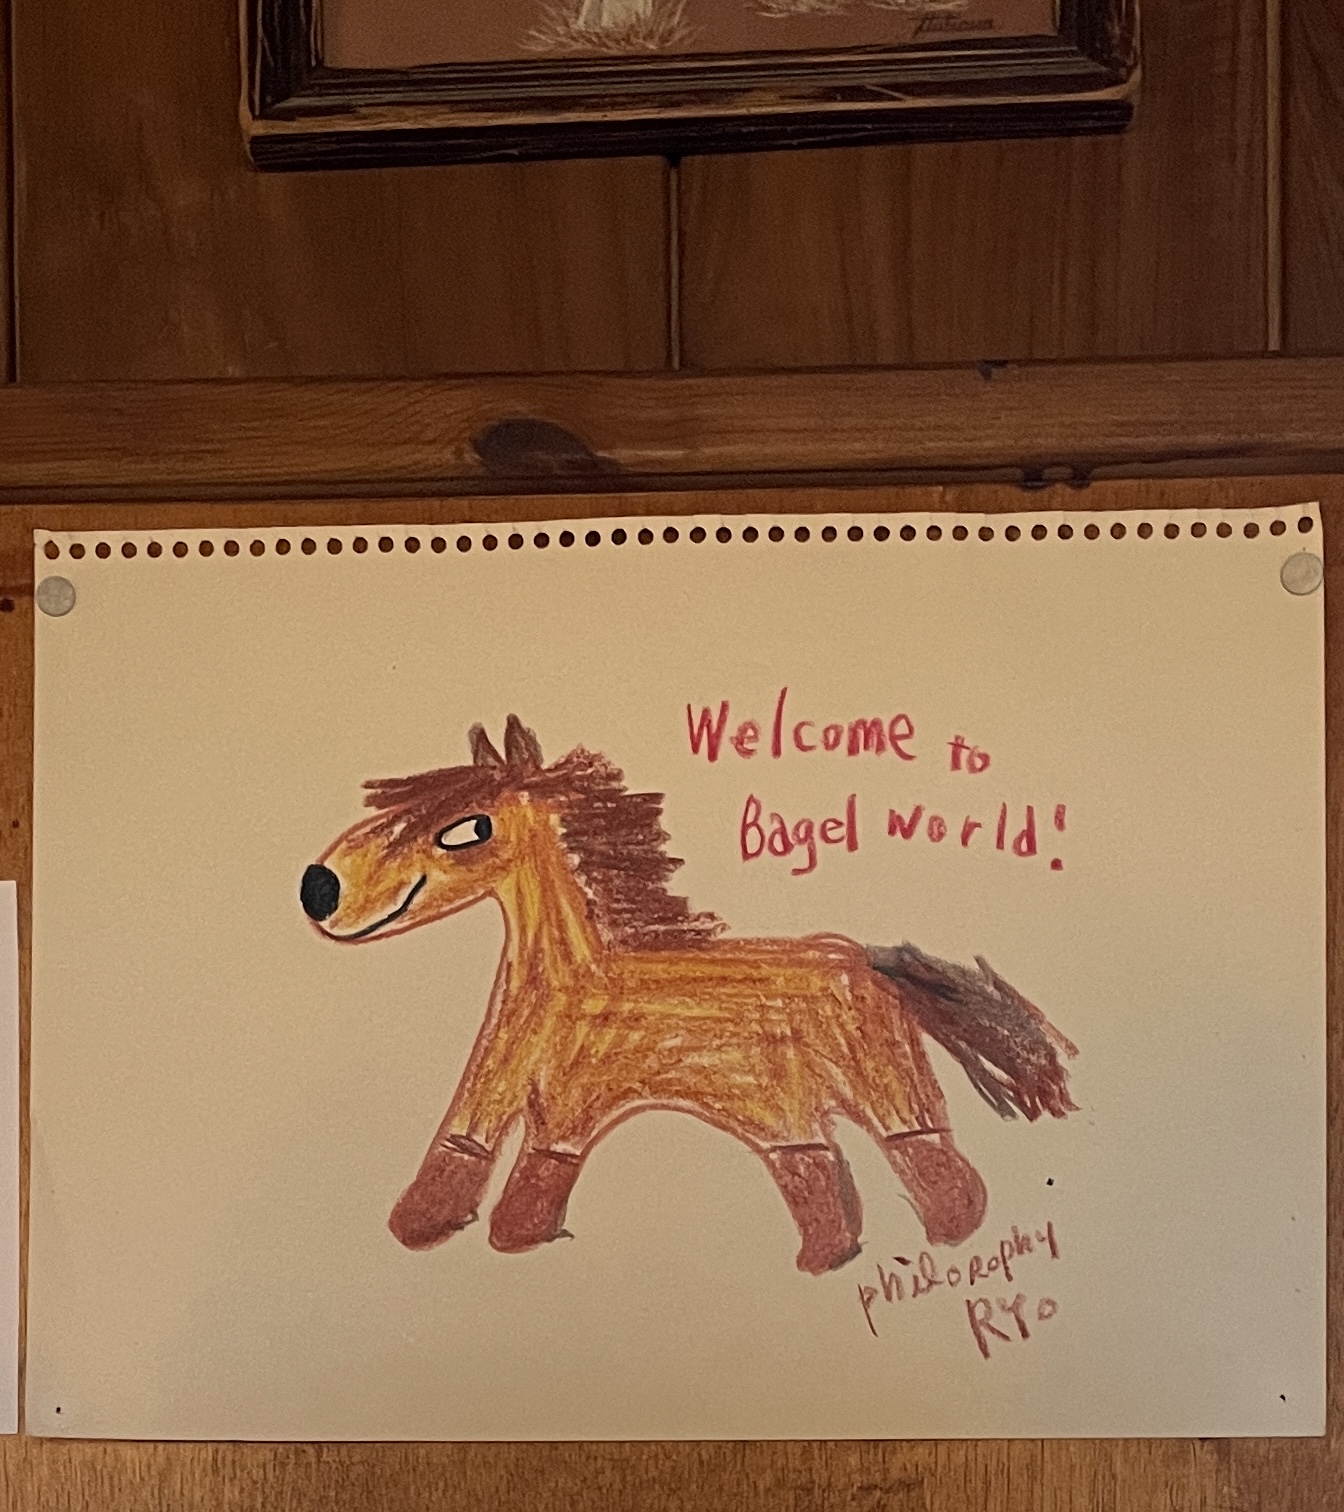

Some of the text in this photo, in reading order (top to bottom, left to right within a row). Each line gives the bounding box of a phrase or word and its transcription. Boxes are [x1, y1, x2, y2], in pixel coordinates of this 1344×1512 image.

[687, 687, 990, 773] Welcome to
[740, 794, 858, 876] Bagel
